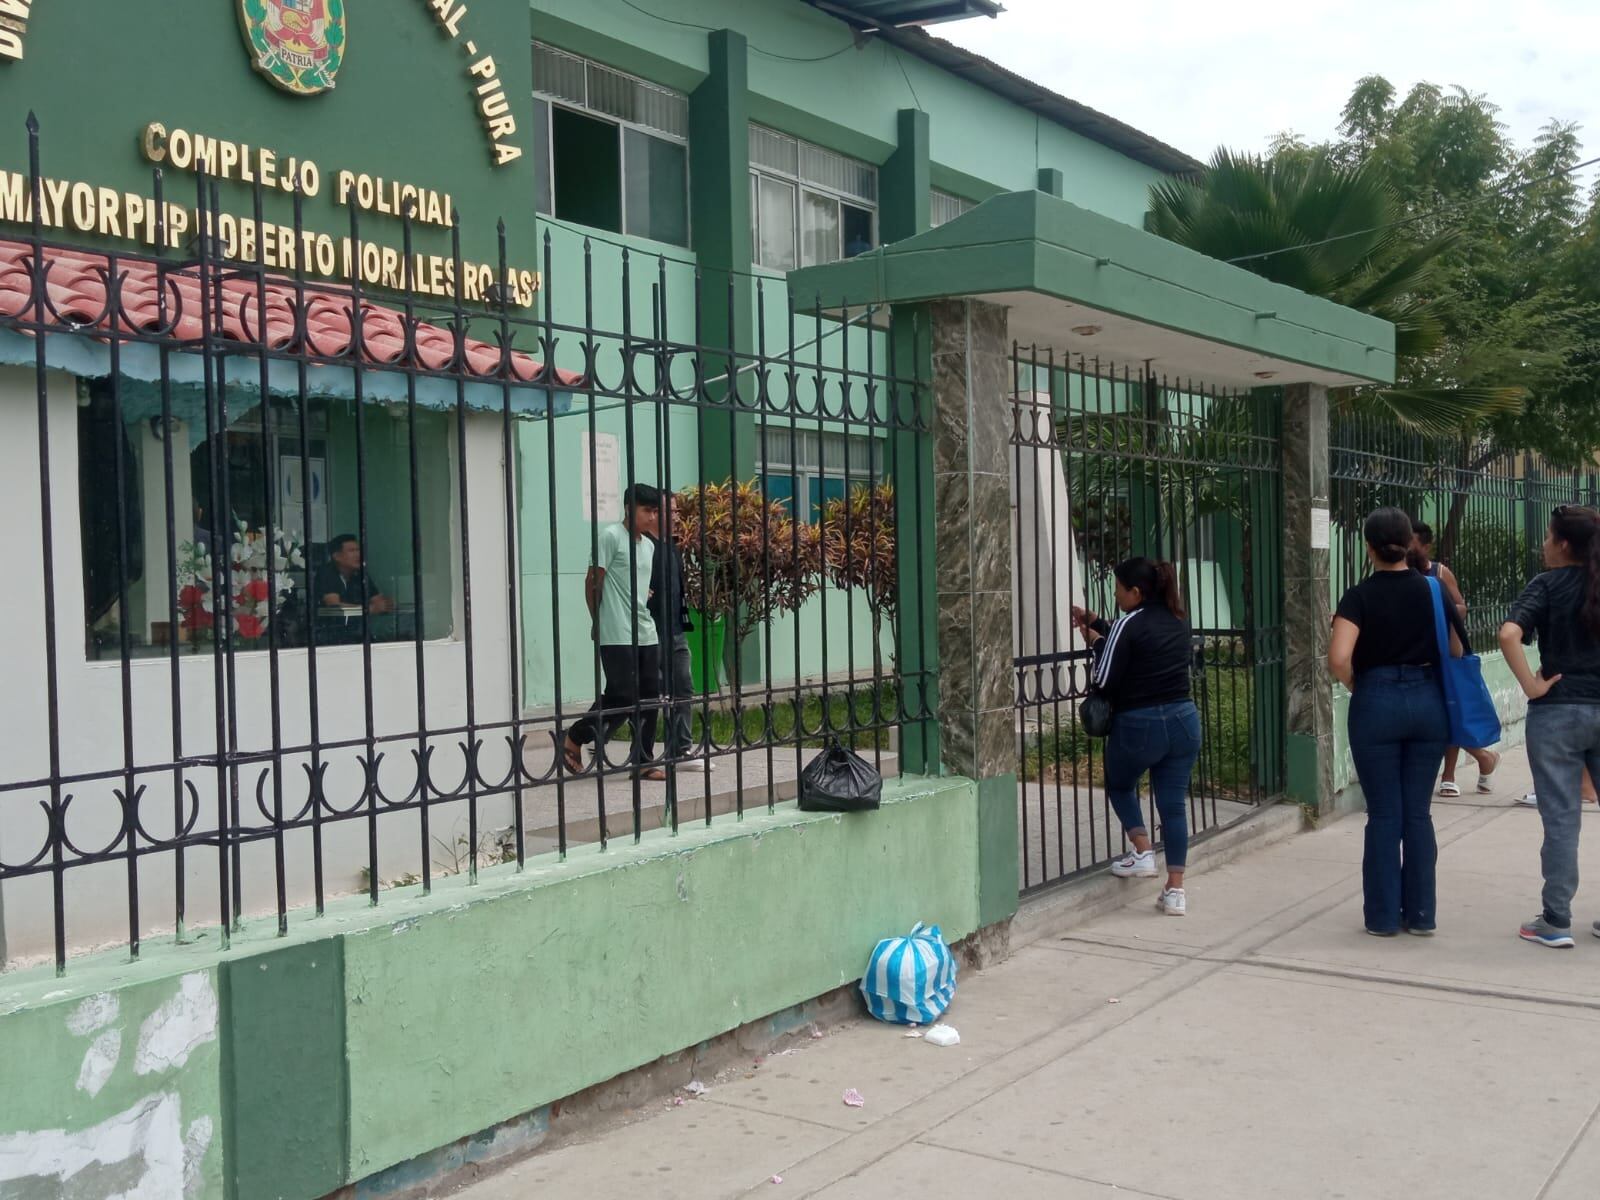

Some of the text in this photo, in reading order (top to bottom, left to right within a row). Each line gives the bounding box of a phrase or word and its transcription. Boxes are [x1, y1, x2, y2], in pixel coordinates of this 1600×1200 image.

[281, 48, 313, 67] PATRIA
[145, 121, 453, 227] COMPLEJO POLICIAL
[463, 261, 543, 308] ROAS"
